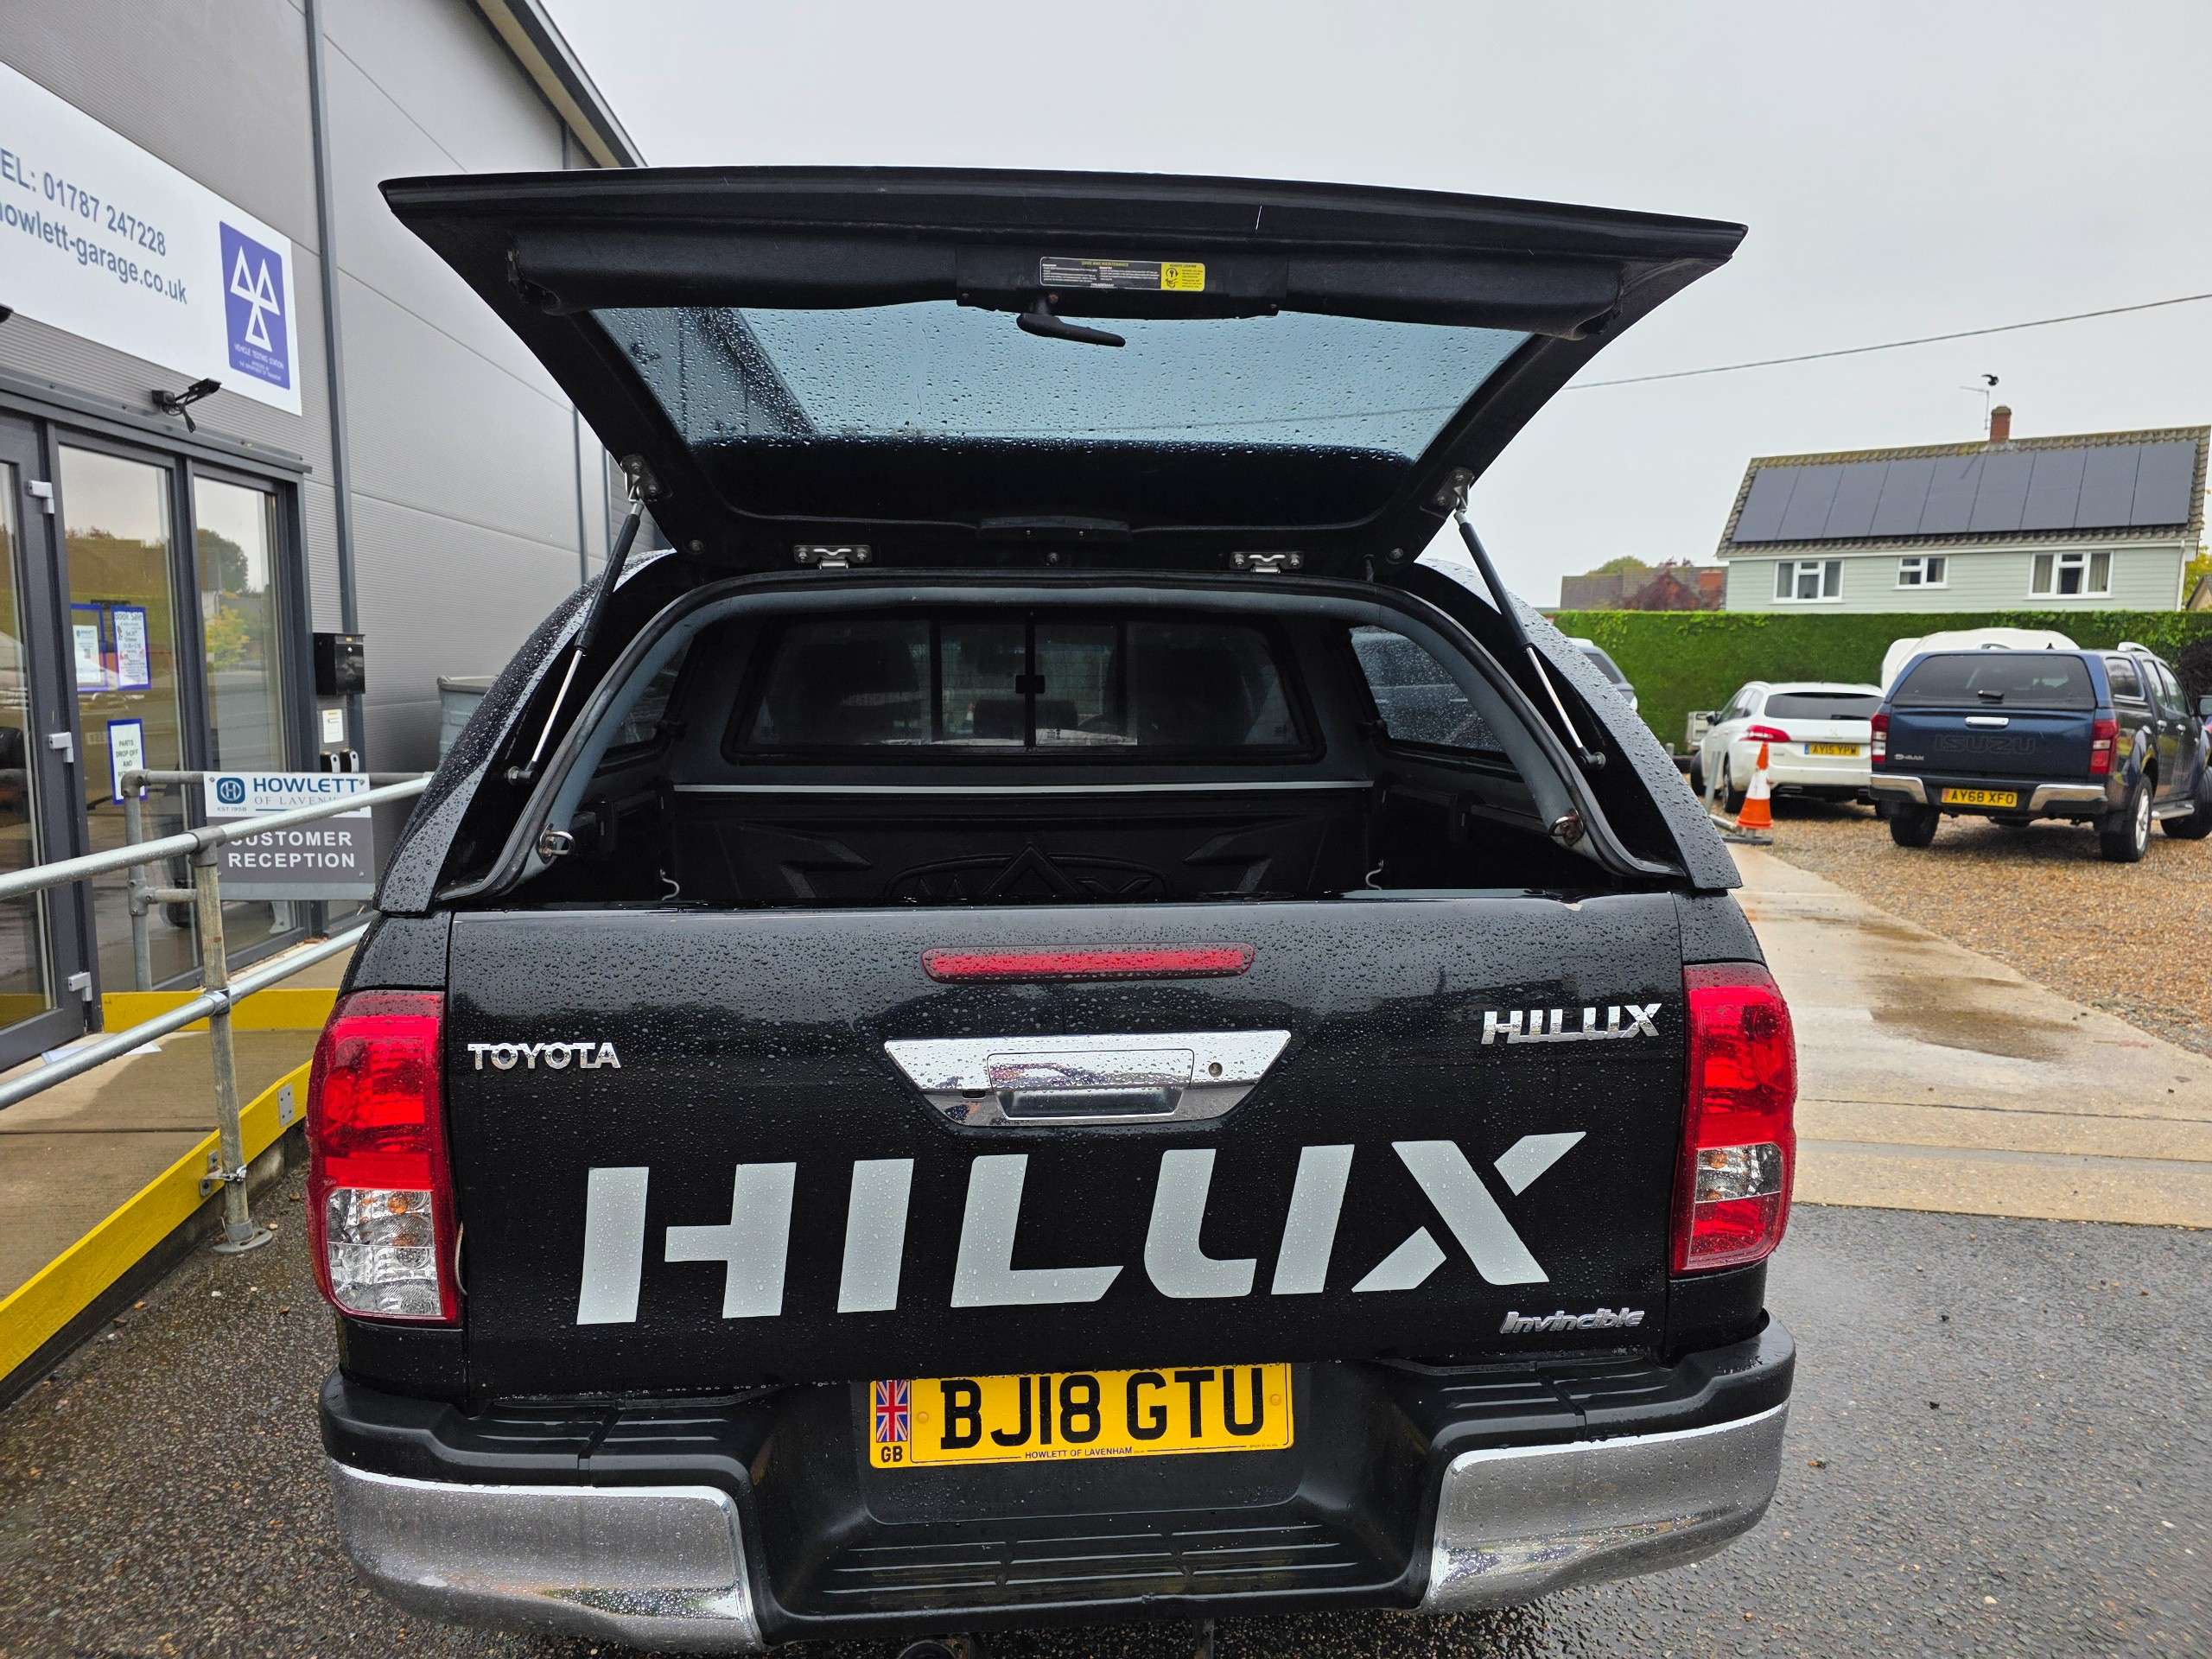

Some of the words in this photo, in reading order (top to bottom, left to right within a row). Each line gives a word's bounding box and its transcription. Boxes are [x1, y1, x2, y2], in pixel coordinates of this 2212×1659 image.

[43, 172, 100, 223] 01787
[106, 205, 167, 257] 247228
[1936, 734, 2036, 754] ISUZU
[254, 778, 359, 793] HOWLETT
[255, 795, 272, 805] OF
[280, 795, 339, 805] LAVEN
[1951, 791, 1984, 801] AY68
[1988, 792, 2015, 804] XFO
[228, 853, 355, 868] RECEPTION
[1481, 1002, 1662, 1044] HILUX
[467, 1042, 621, 1070] TOYOTA
[577, 1132, 1587, 1325] HILUX
[1499, 1307, 1645, 1334] Invincible
[940, 1375, 1100, 1449] BJ18
[1126, 1368, 1263, 1440] GTU
[880, 1446, 903, 1463] GB
[1025, 1450, 1067, 1459] HOWLETT
[1084, 1446, 1133, 1457] LAVENHAM
